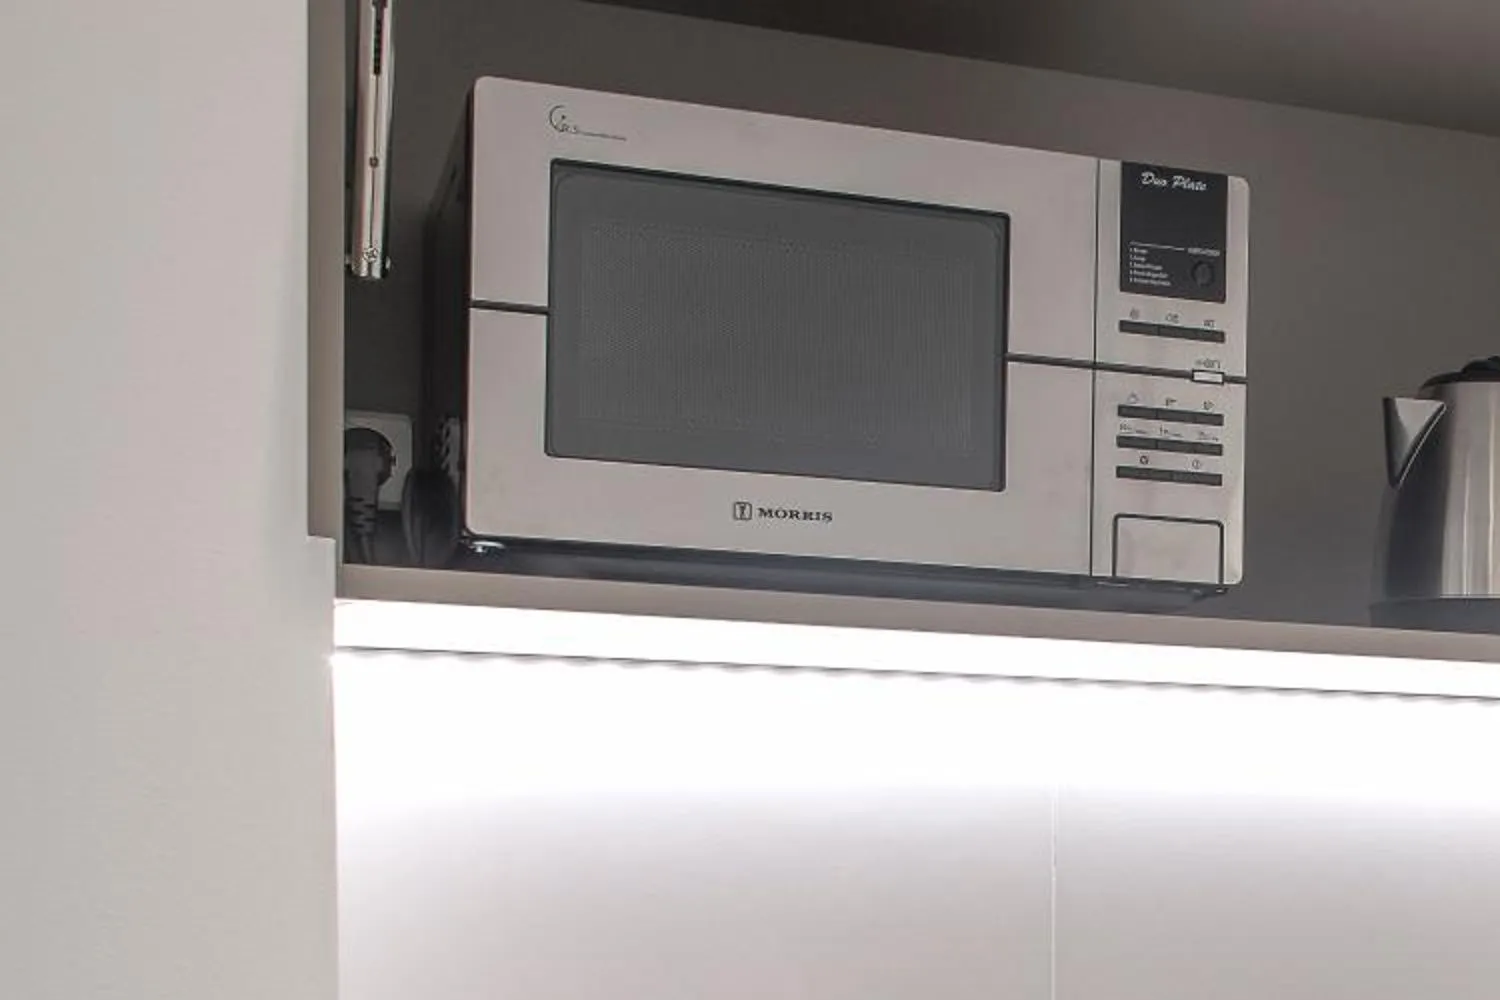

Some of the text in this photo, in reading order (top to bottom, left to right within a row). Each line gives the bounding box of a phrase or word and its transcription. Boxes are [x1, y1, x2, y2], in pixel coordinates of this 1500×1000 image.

[1141, 171, 1207, 191] Duo Plate
[757, 507, 833, 523] MORRIS
